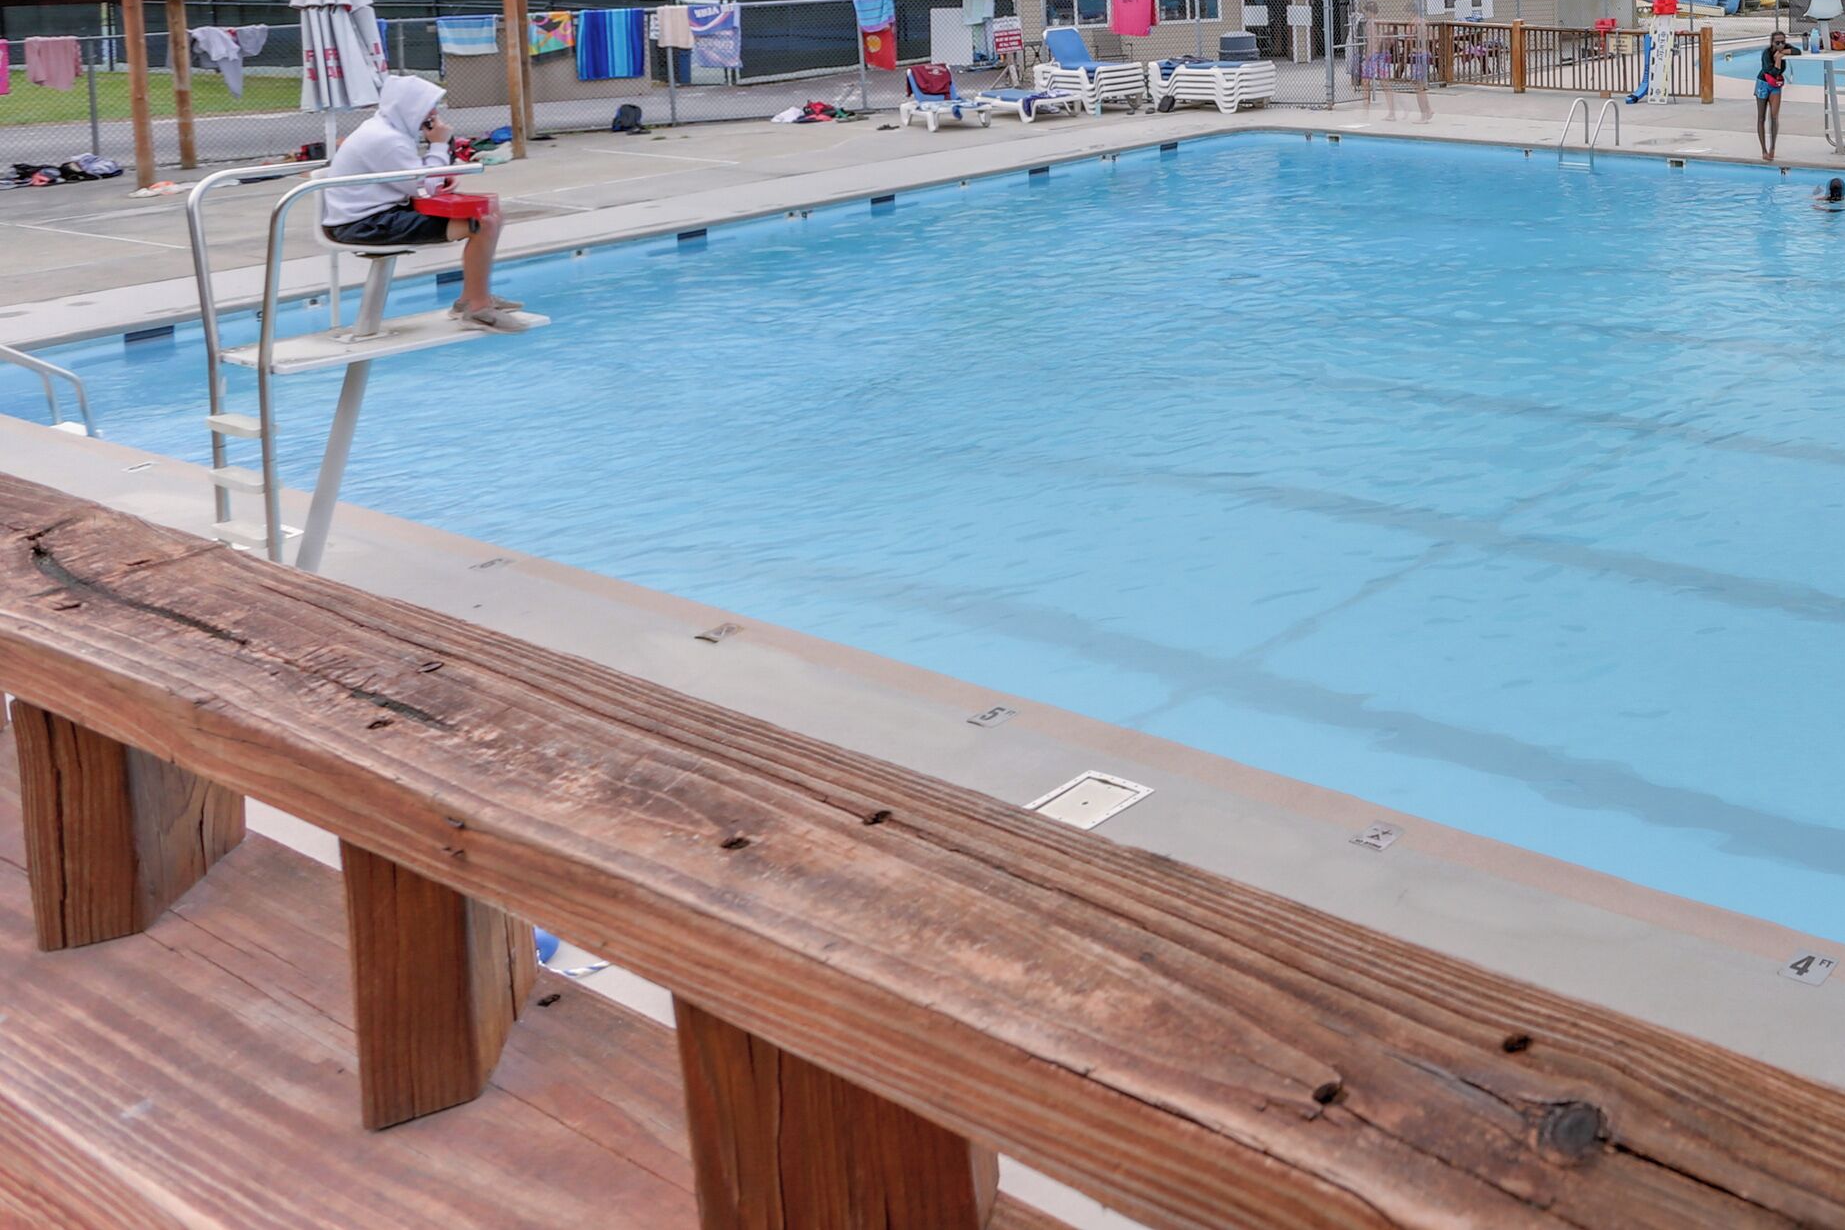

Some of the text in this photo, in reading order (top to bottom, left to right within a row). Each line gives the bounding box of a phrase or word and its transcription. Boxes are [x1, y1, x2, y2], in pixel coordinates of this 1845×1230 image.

[980, 706, 1006, 721] 5
[1789, 955, 1834, 976] 4 FT
